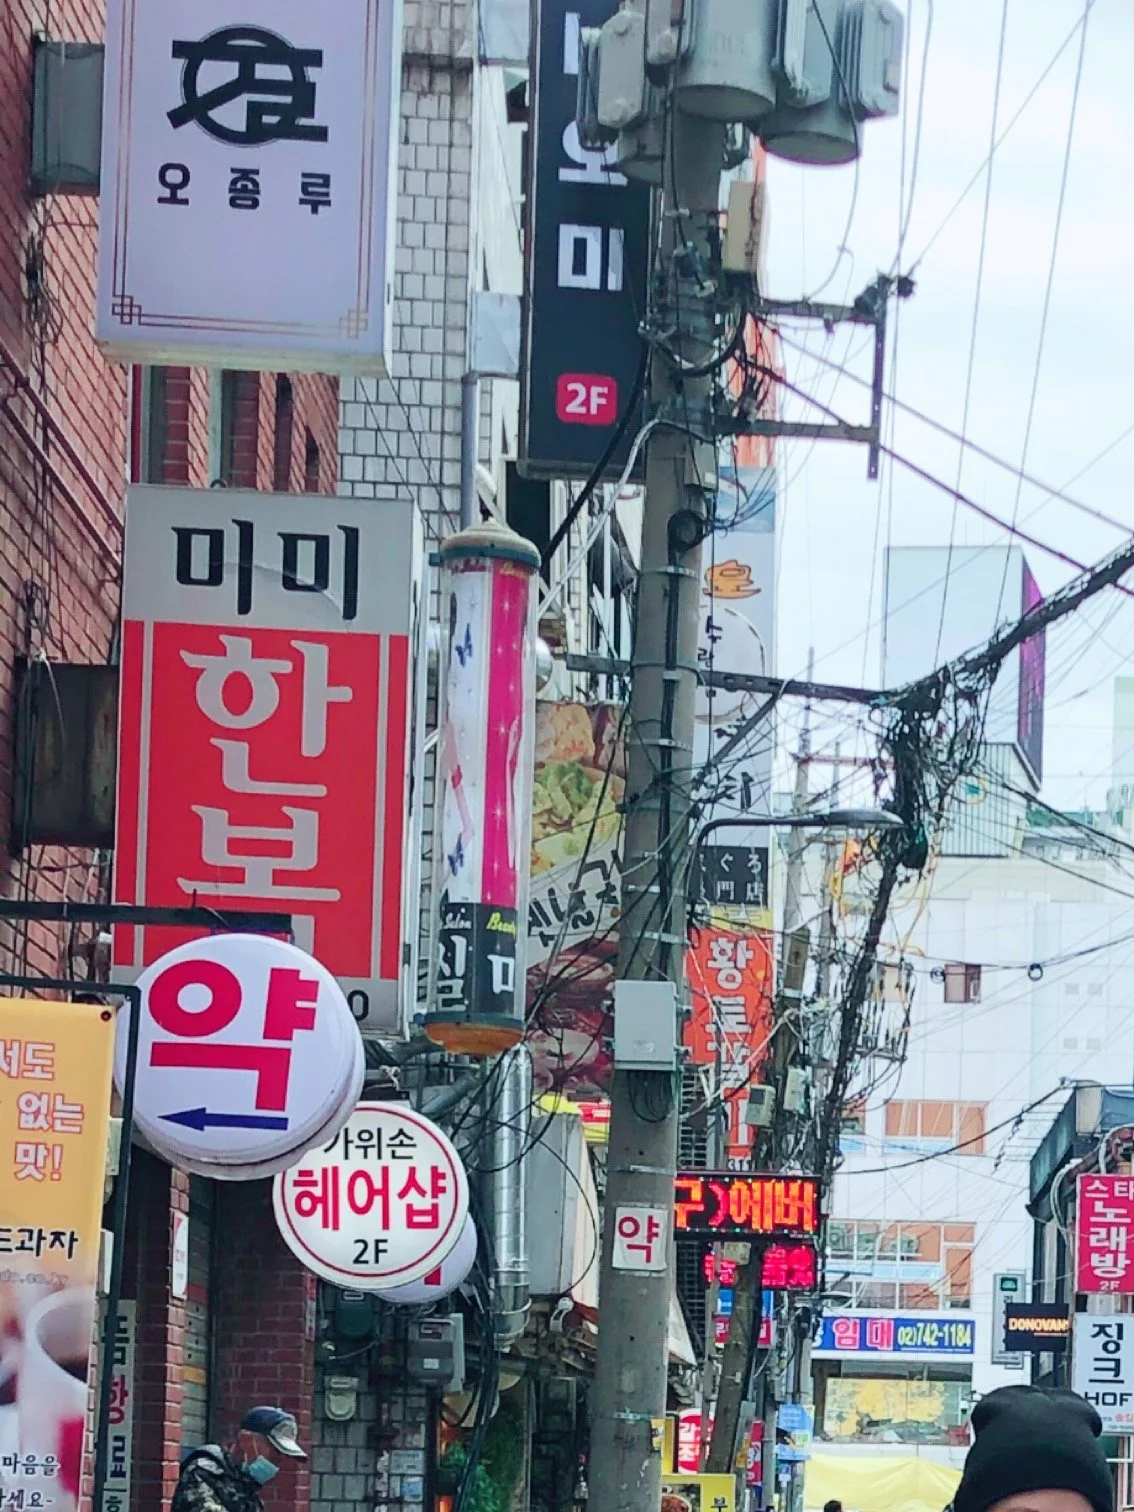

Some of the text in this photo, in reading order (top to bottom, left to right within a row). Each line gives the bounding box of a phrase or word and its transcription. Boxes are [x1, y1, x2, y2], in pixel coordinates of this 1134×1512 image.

[157, 162, 332, 214] 오종루
[564, 381, 609, 416] 2F
[170, 519, 359, 620] 미미
[147, 958, 320, 1112] 약
[17, 1090, 84, 1134] 없는
[13, 1140, 64, 1182] 맛!
[323, 1126, 418, 1162] 가위손
[292, 1164, 447, 1231] 헤어샵
[351, 1238, 389, 1265] 2F
[617, 1215, 661, 1264] 약
[1088, 1200, 1132, 1279] 노래방
[1099, 1280, 1121, 1291] 2F
[832, 1317, 895, 1351] 임대
[1088, 1322, 1125, 1385] 징크
[1084, 1391, 1134, 1407] HOF
[2, 1452, 59, 1477] 마음을
